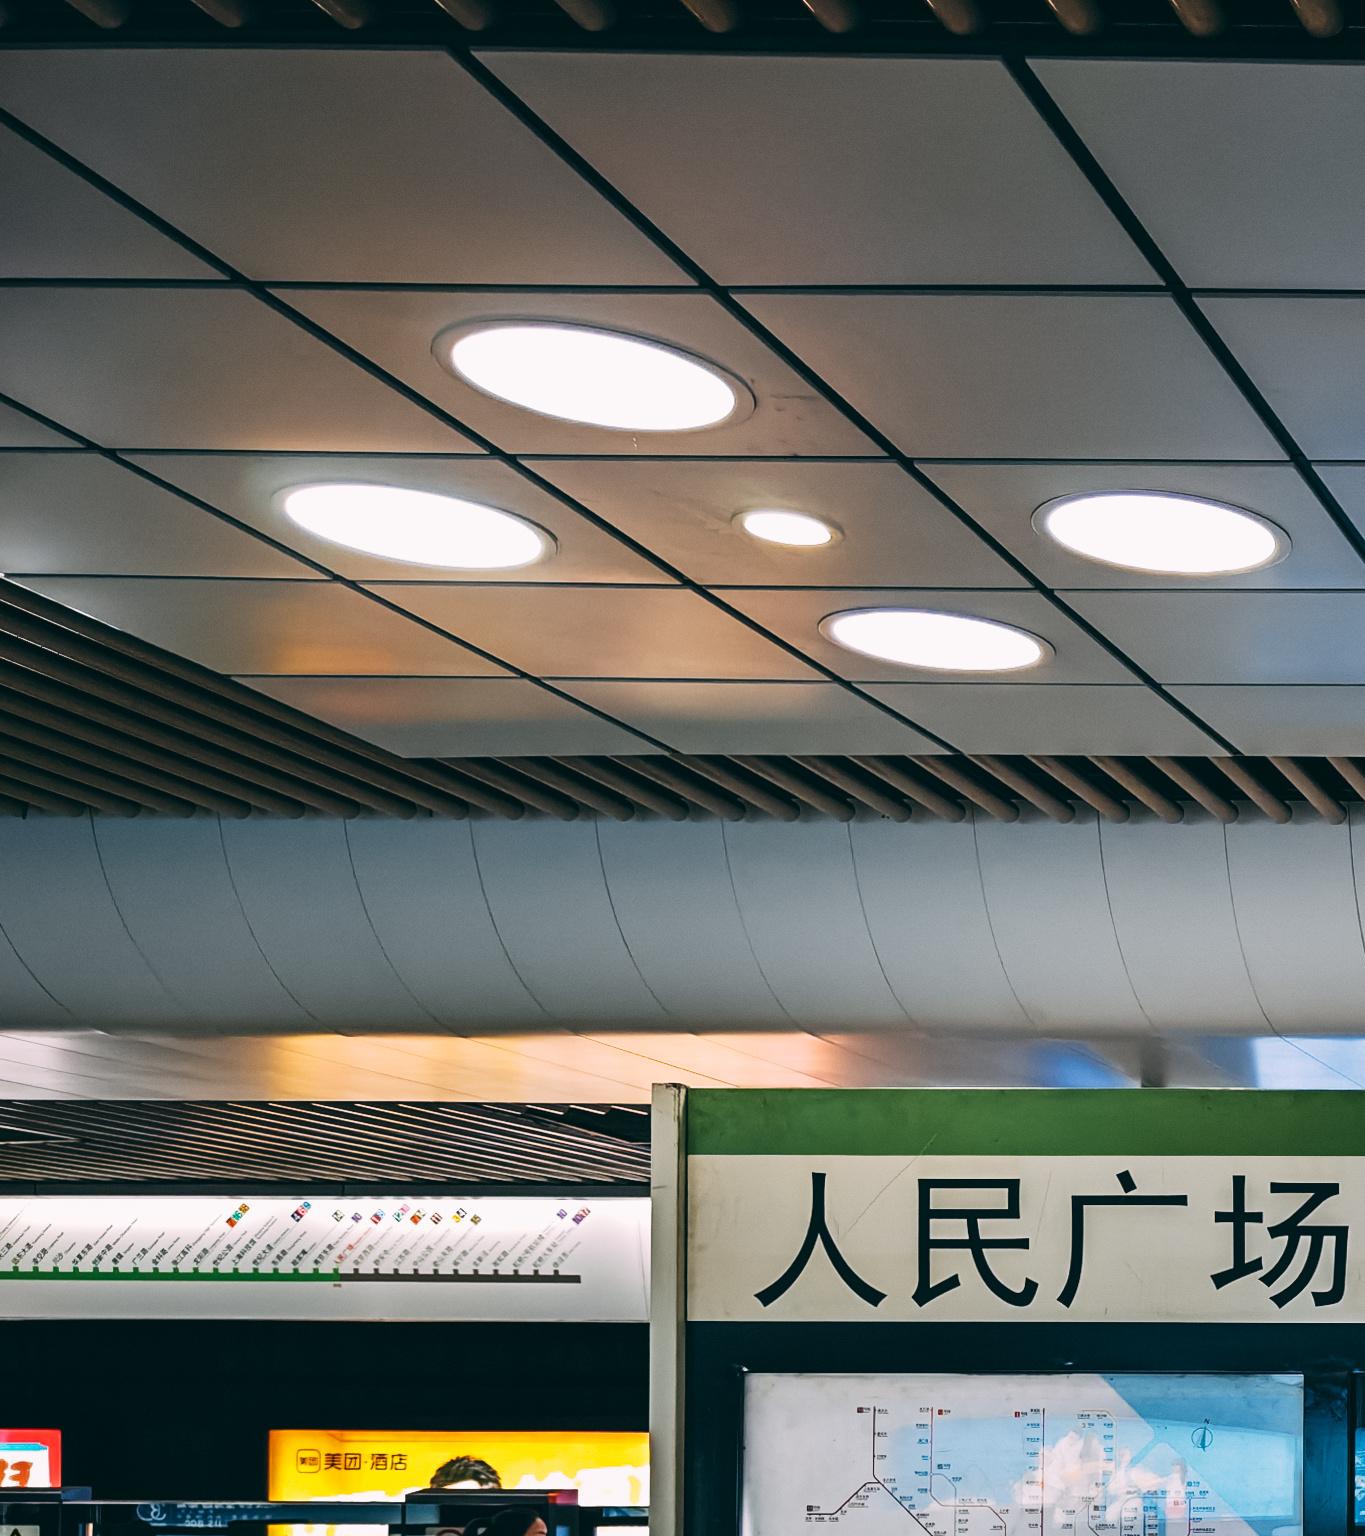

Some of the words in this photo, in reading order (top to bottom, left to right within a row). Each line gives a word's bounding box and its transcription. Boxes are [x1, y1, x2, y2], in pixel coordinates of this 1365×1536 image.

[754, 1169, 1350, 1309] 人民广场
[324, 1453, 407, 1471] 美团·酒店
